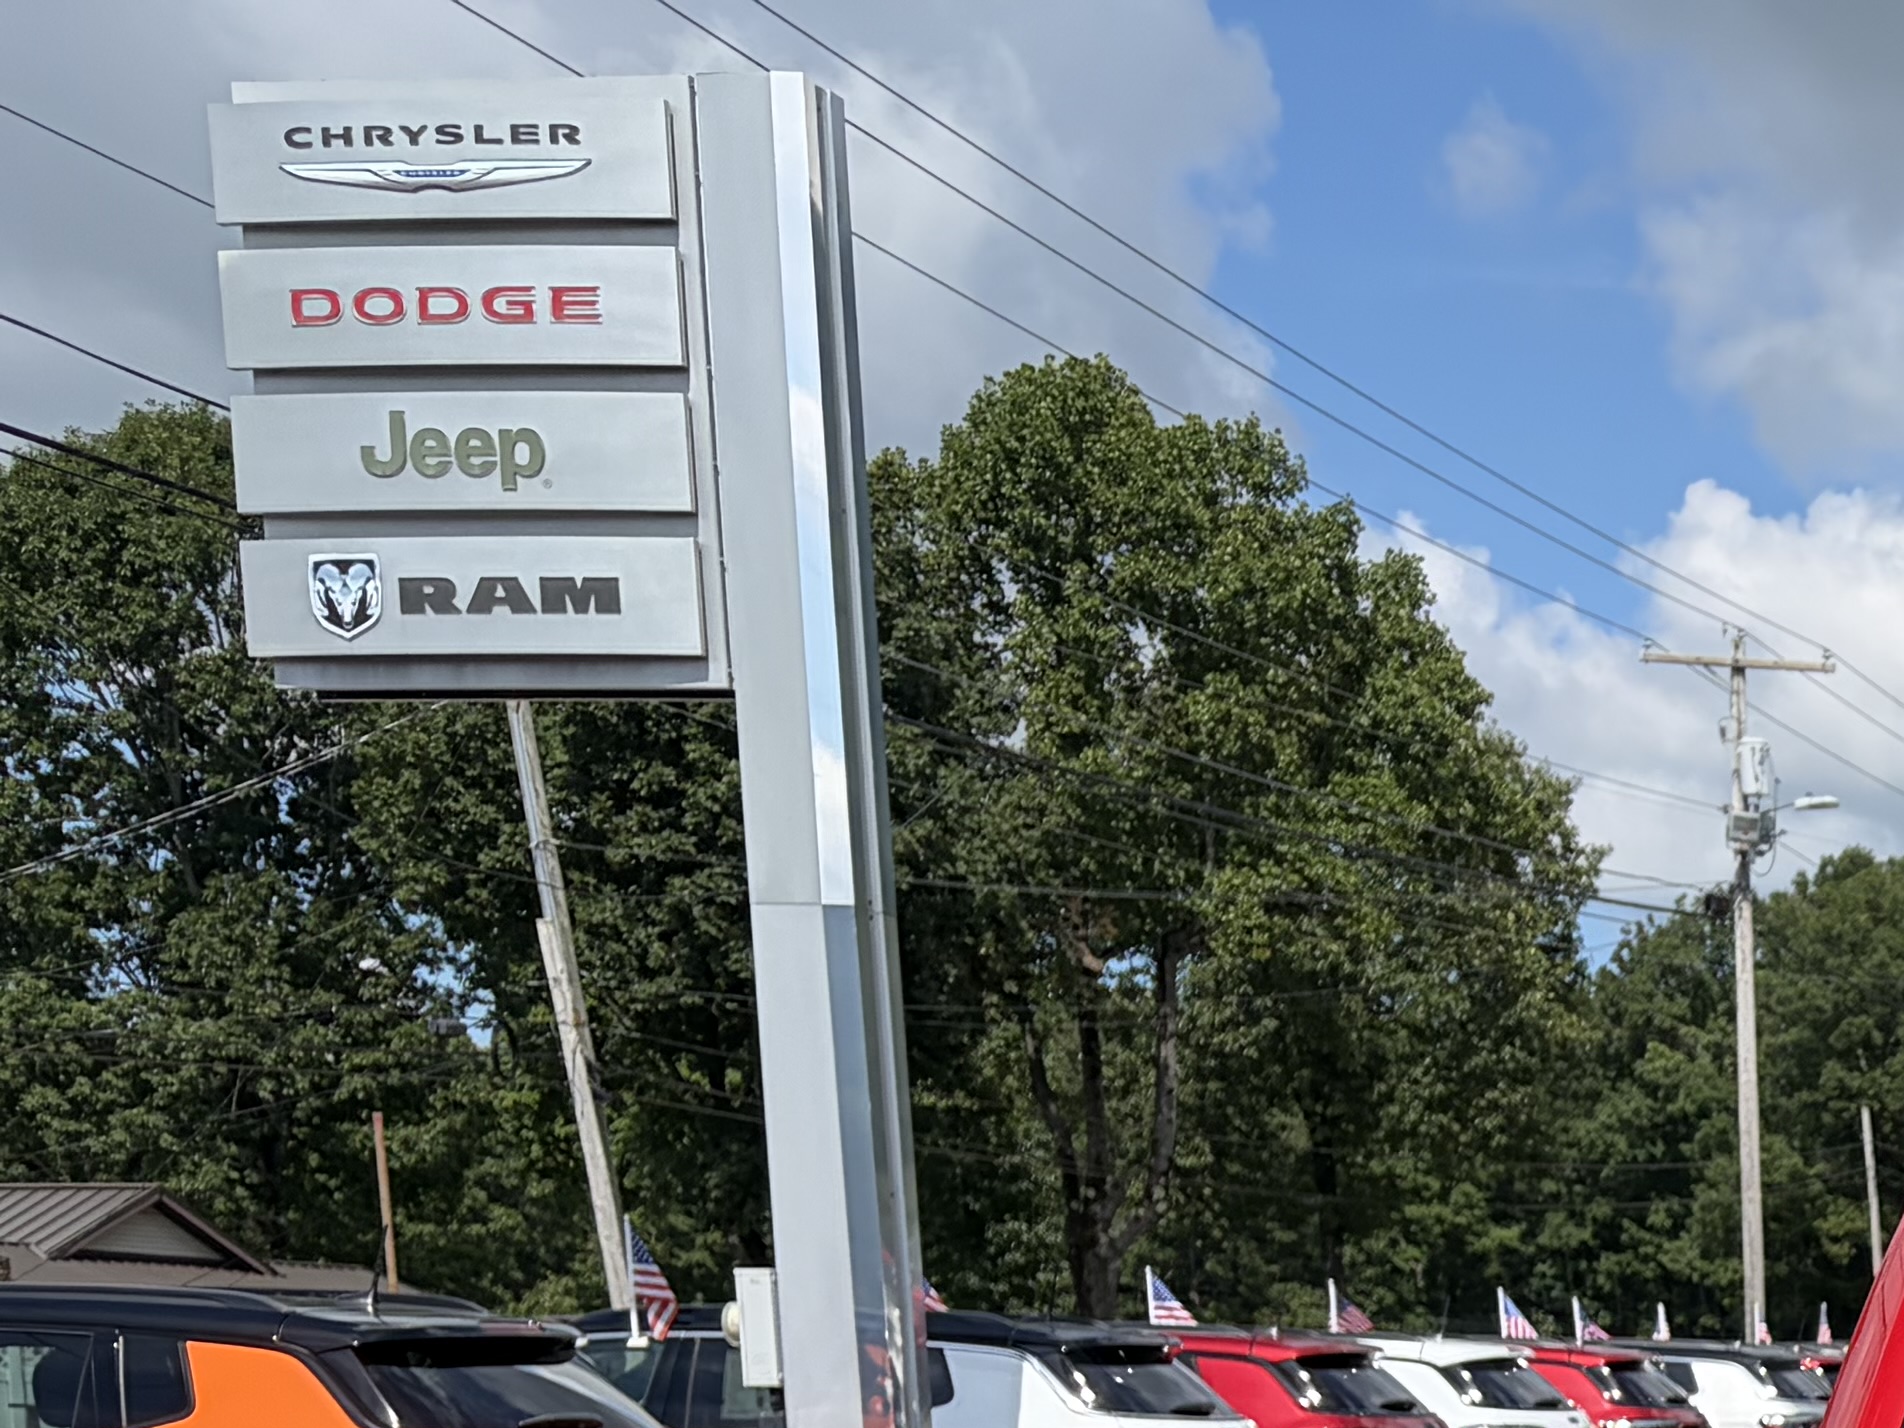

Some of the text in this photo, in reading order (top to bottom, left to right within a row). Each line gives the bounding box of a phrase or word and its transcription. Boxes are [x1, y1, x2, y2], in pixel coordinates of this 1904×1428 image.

[283, 123, 582, 150] CHRYSLER
[289, 285, 603, 328] DODGE
[360, 410, 546, 491] Jeep
[398, 576, 621, 615] RAM
